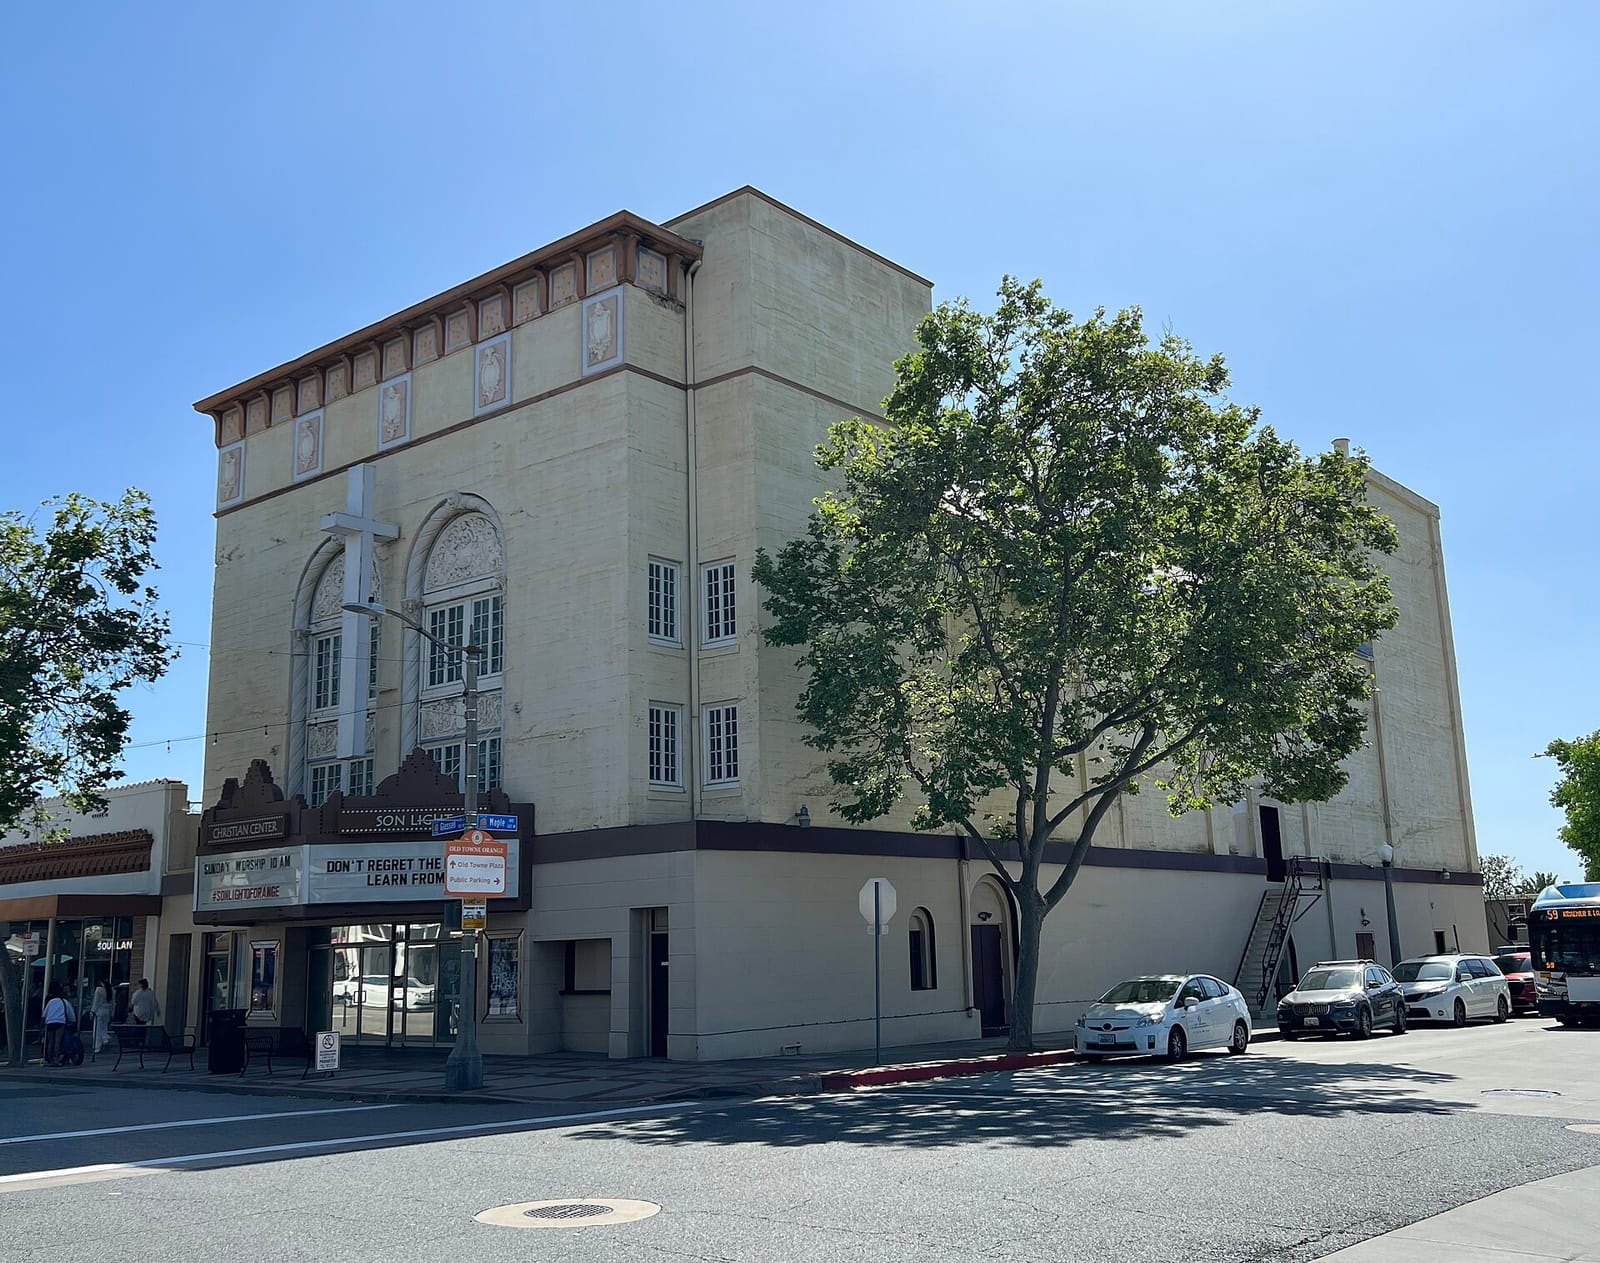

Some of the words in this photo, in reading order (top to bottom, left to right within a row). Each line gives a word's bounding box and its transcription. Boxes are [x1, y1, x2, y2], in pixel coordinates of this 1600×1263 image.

[376, 815, 405, 827] SON
[489, 818, 505, 828] Maple
[213, 825, 249, 839] CHRISTIAN
[250, 822, 277, 834] CENTER
[205, 862, 230, 874] SUNDAY
[235, 858, 266, 871] WORSHIP
[270, 856, 277, 868] 10
[280, 855, 291, 867] AM
[327, 860, 364, 873] DON'T
[368, 858, 414, 871] REGRET
[418, 857, 441, 870] THE
[367, 873, 408, 886] LEARN
[412, 872, 445, 885] FROM
[469, 876, 491, 885] Parking
[213, 886, 280, 901] #SONLIGHTOFORANGE
[1547, 910, 1558, 920] 59
